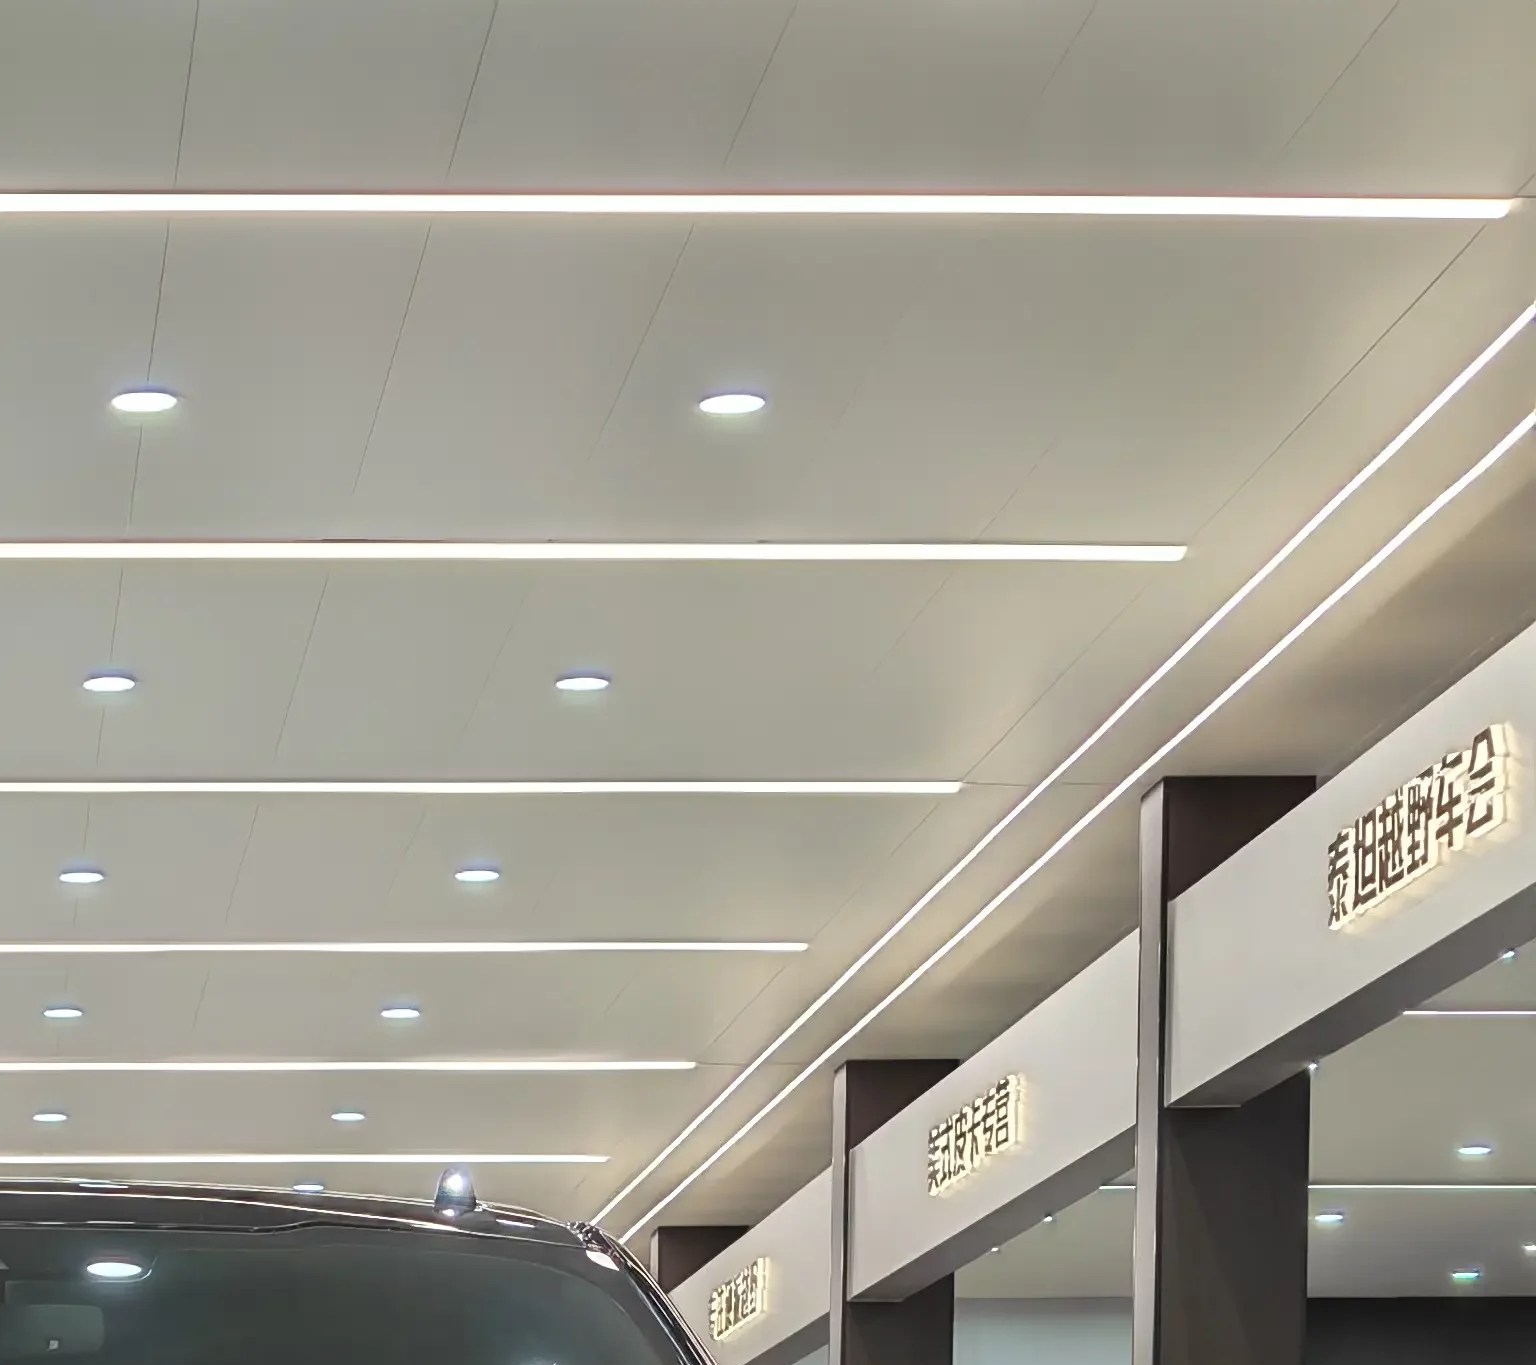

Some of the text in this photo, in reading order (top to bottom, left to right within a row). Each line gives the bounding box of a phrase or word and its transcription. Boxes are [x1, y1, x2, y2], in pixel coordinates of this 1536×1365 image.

[1327, 724, 1507, 929] 泰坦越野车会
[927, 1076, 1016, 1195] 美式皮卡专营
